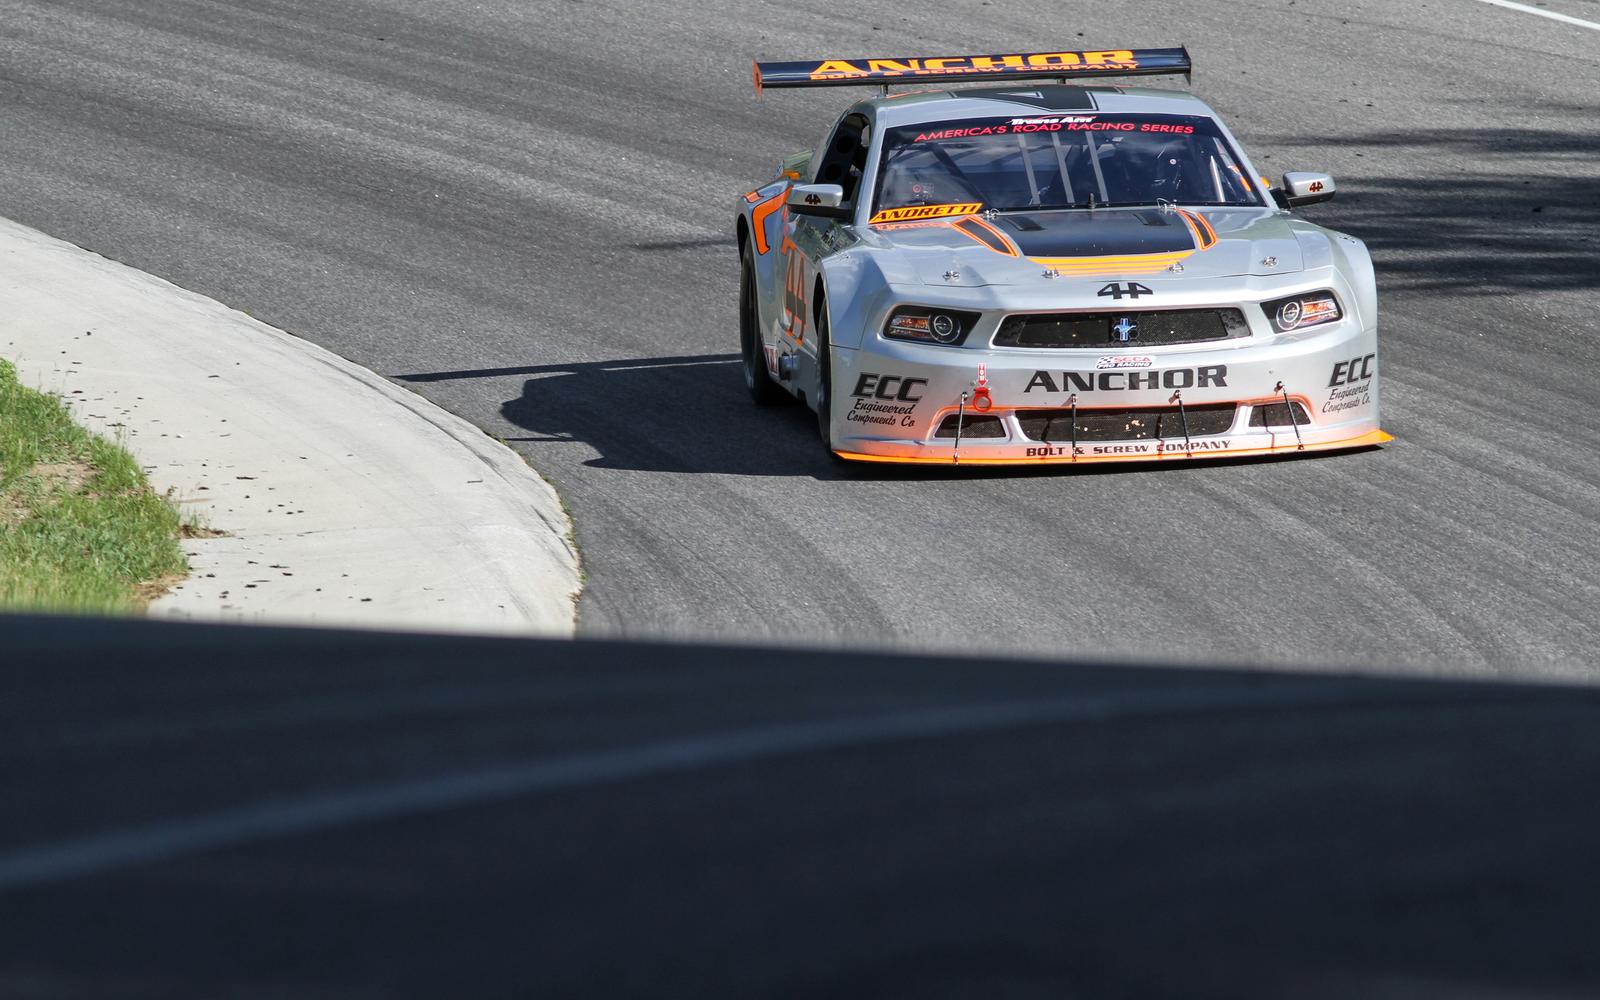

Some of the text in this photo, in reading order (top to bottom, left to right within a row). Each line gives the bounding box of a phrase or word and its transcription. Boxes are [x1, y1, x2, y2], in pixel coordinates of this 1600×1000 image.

[810, 50, 1138, 74] ANCHOR
[914, 67, 1004, 75] SCREW
[1015, 63, 1139, 71] COMPANY
[1006, 118, 1060, 126] Trans
[914, 122, 1194, 142] AMERICA'S ROAD RACING SERIES
[1309, 181, 1324, 193] 44
[804, 193, 822, 205] 44
[876, 205, 977, 220] ANDRETTI
[1097, 282, 1154, 300] 44
[1024, 364, 1229, 393] ANCHOR
[1328, 353, 1376, 387] ECC
[850, 372, 928, 403] ECC
[1329, 380, 1371, 401] Engineered
[853, 399, 916, 415] Engineered
[1322, 397, 1361, 413] Components
[847, 410, 896, 426] Components
[1026, 439, 1231, 457] BOLT & SCREW COMPANY
